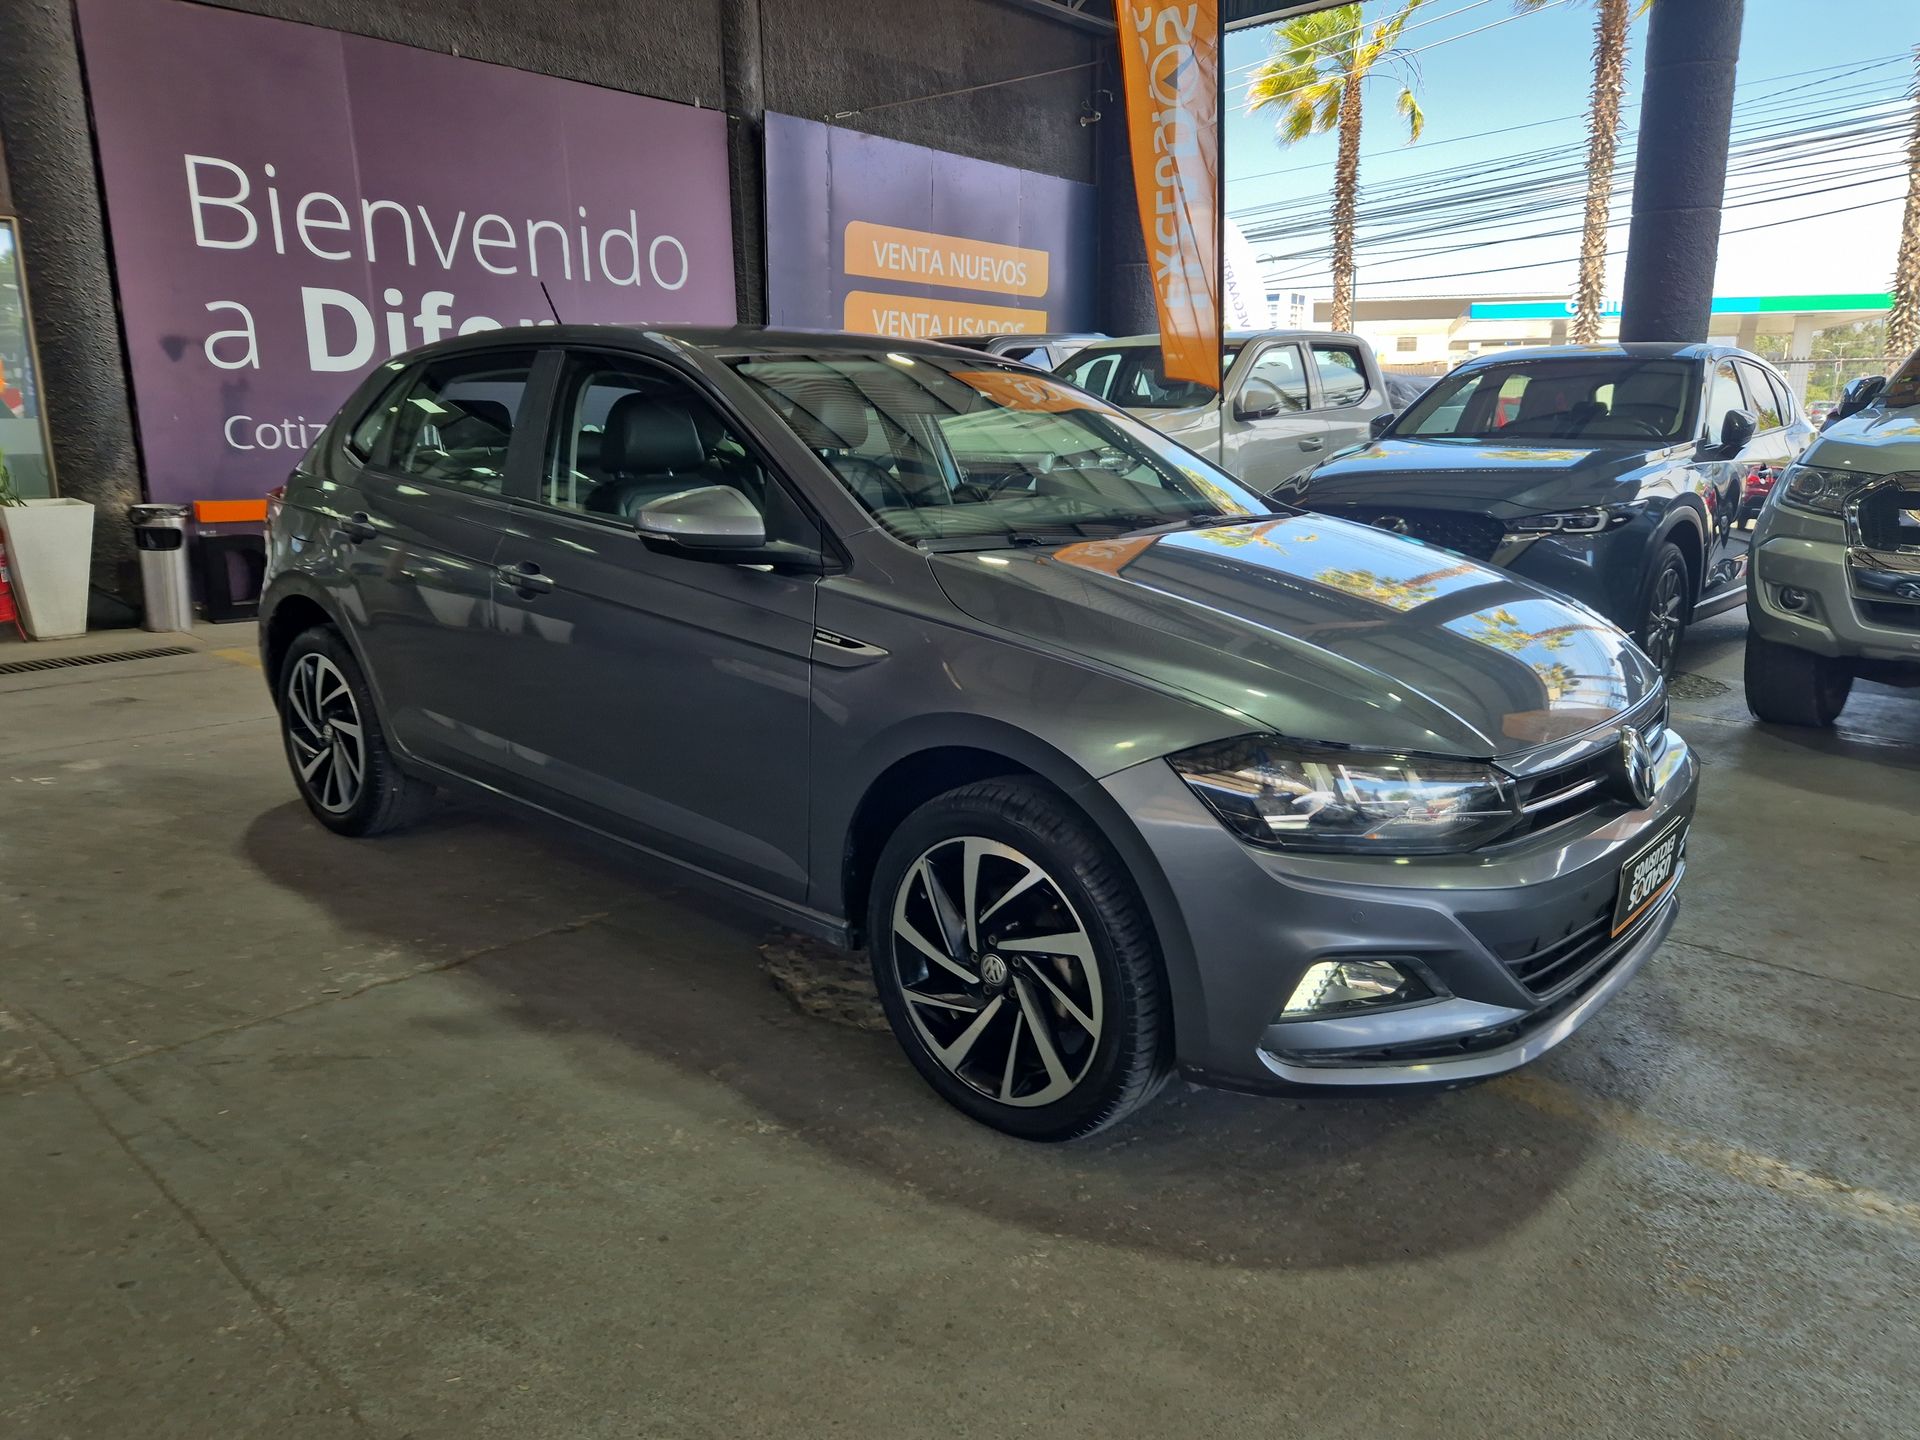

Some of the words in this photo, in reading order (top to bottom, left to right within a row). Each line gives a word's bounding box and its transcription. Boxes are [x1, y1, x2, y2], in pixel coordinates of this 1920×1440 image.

[184, 153, 689, 291] Bienvenido
[873, 240, 944, 276] VENTA
[950, 252, 1026, 286] NUEVOS
[204, 299, 260, 370] a
[301, 286, 556, 372] Dif
[872, 309, 942, 338] VENTA
